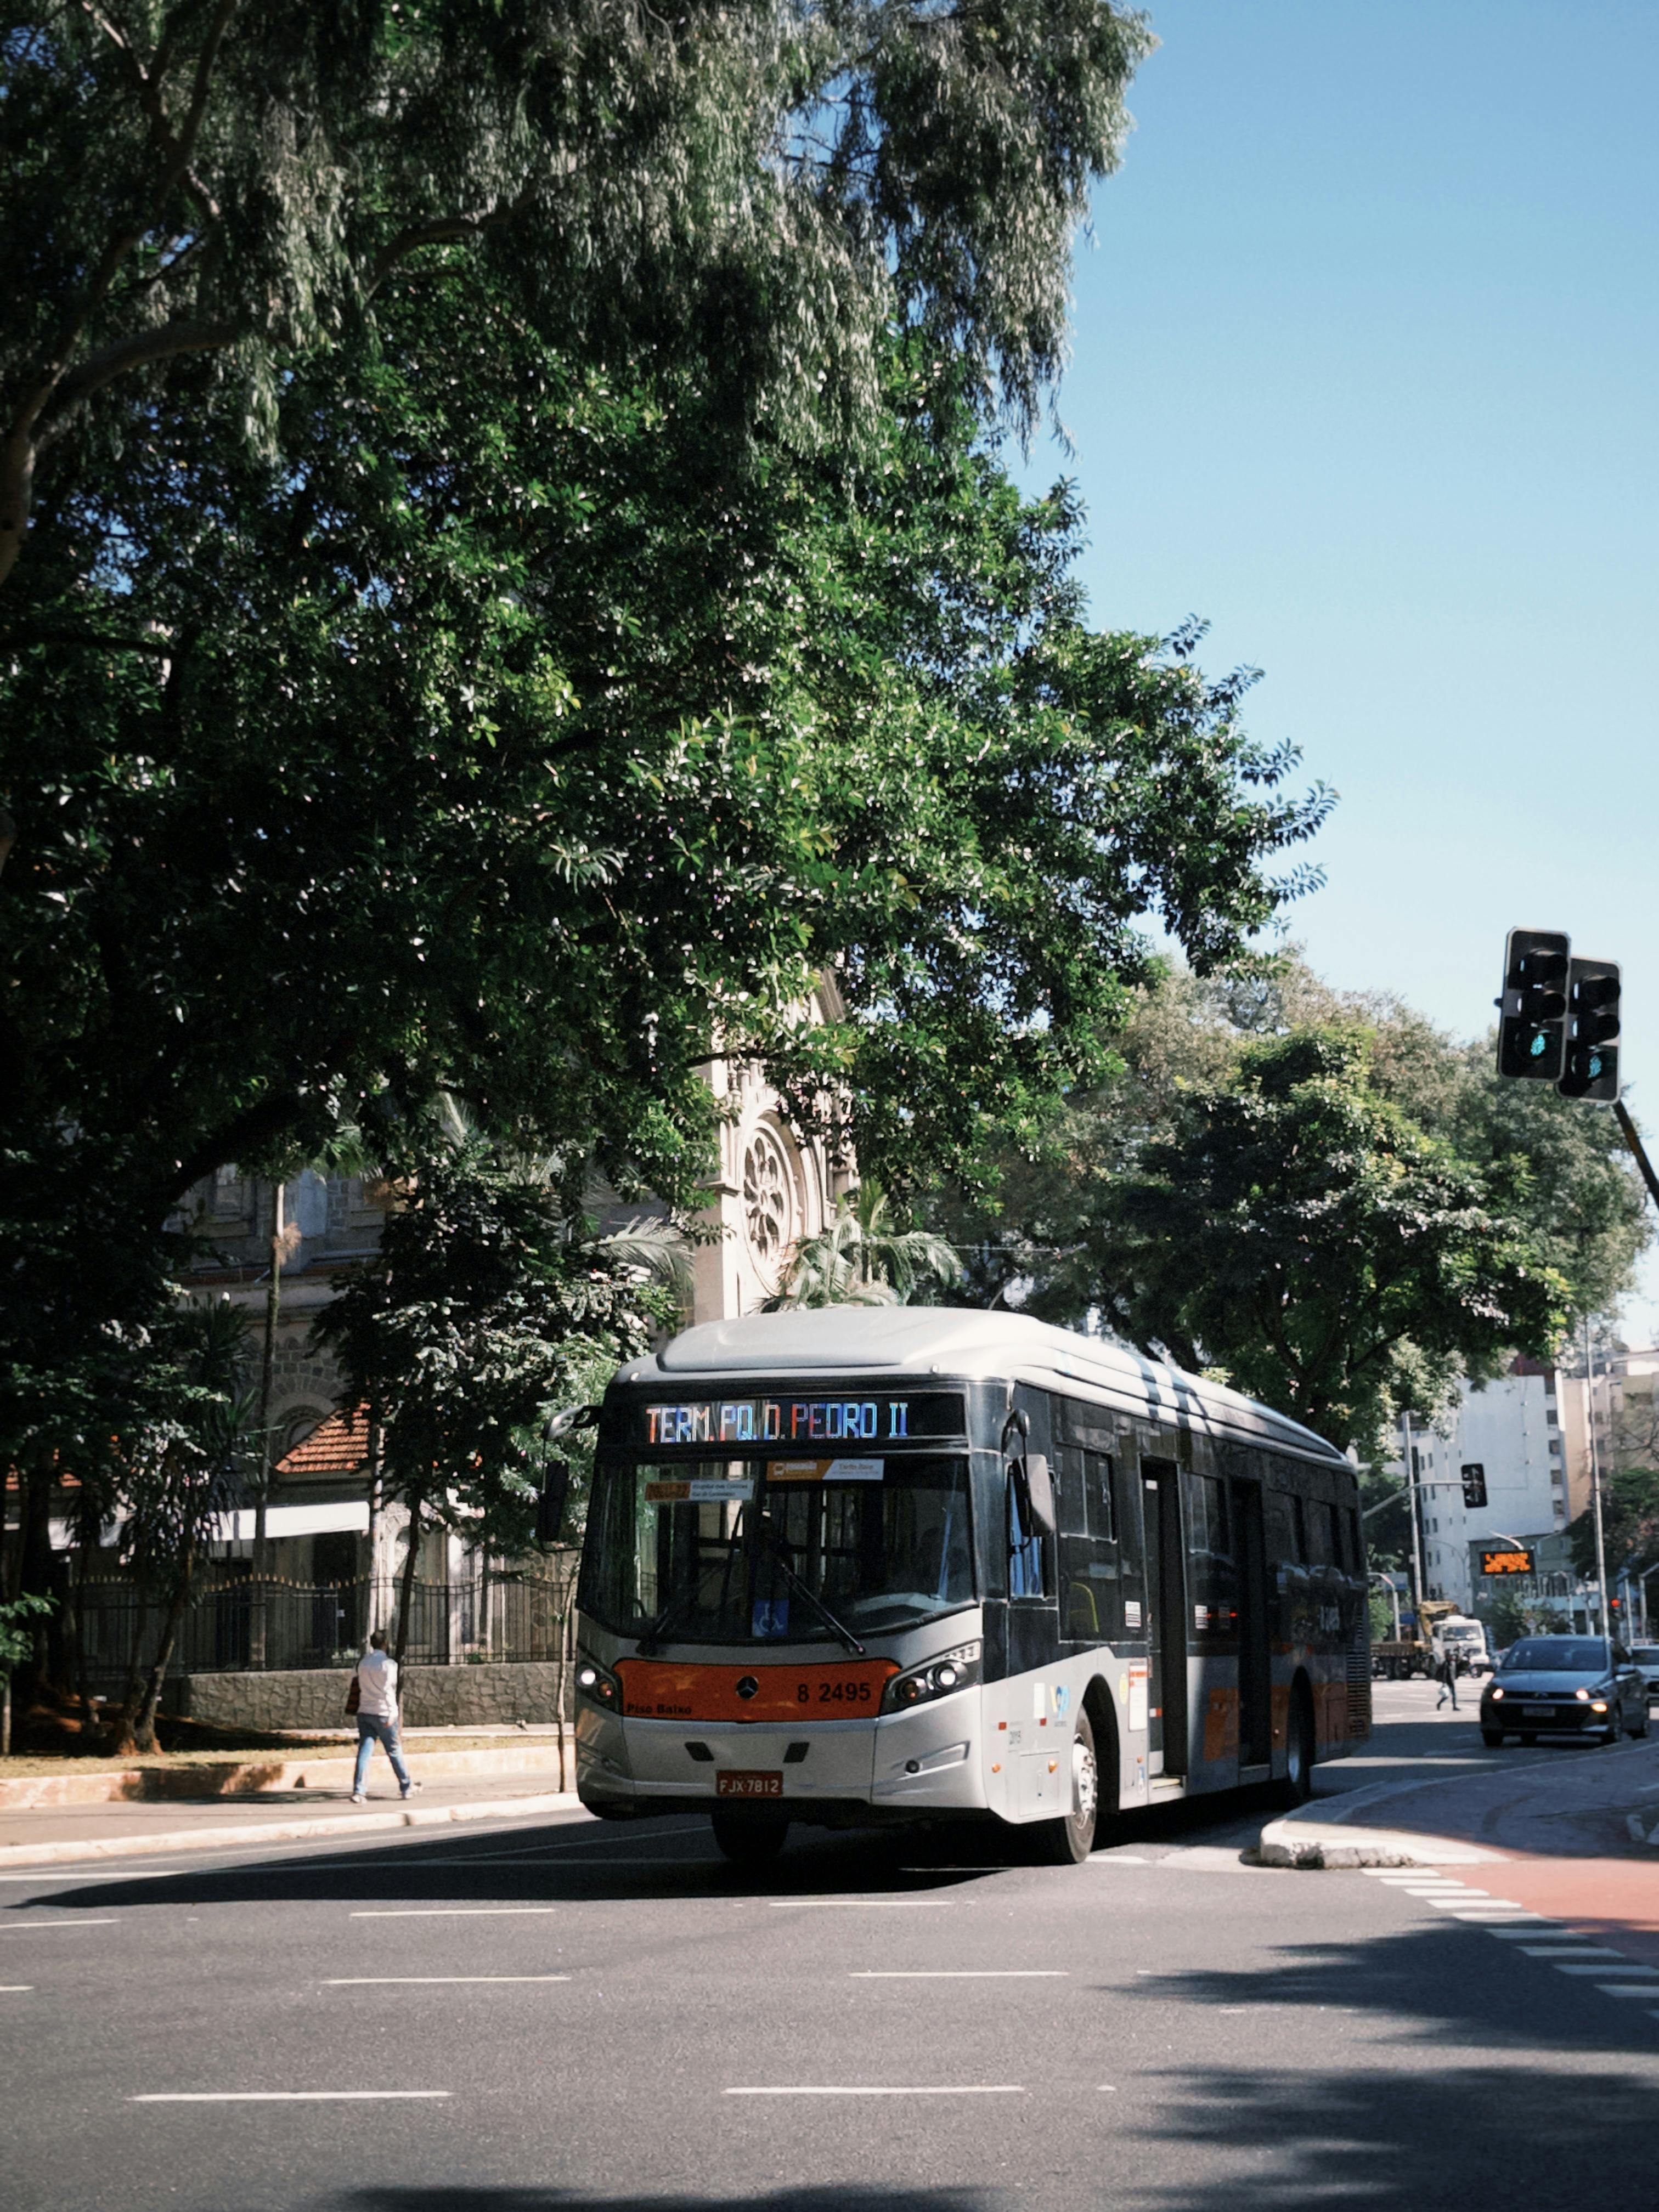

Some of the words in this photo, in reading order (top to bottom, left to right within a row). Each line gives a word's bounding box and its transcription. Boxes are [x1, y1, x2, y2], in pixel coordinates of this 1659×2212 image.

[646, 1406, 714, 1443] TERM.
[719, 1405, 759, 1441] PQ.
[791, 1402, 877, 1439] PEDRO
[889, 1402, 909, 1438] II
[797, 1684, 810, 1703] 8
[819, 1683, 871, 1702] 2495
[627, 1703, 652, 1715] Piso
[657, 1703, 692, 1715] Baixo
